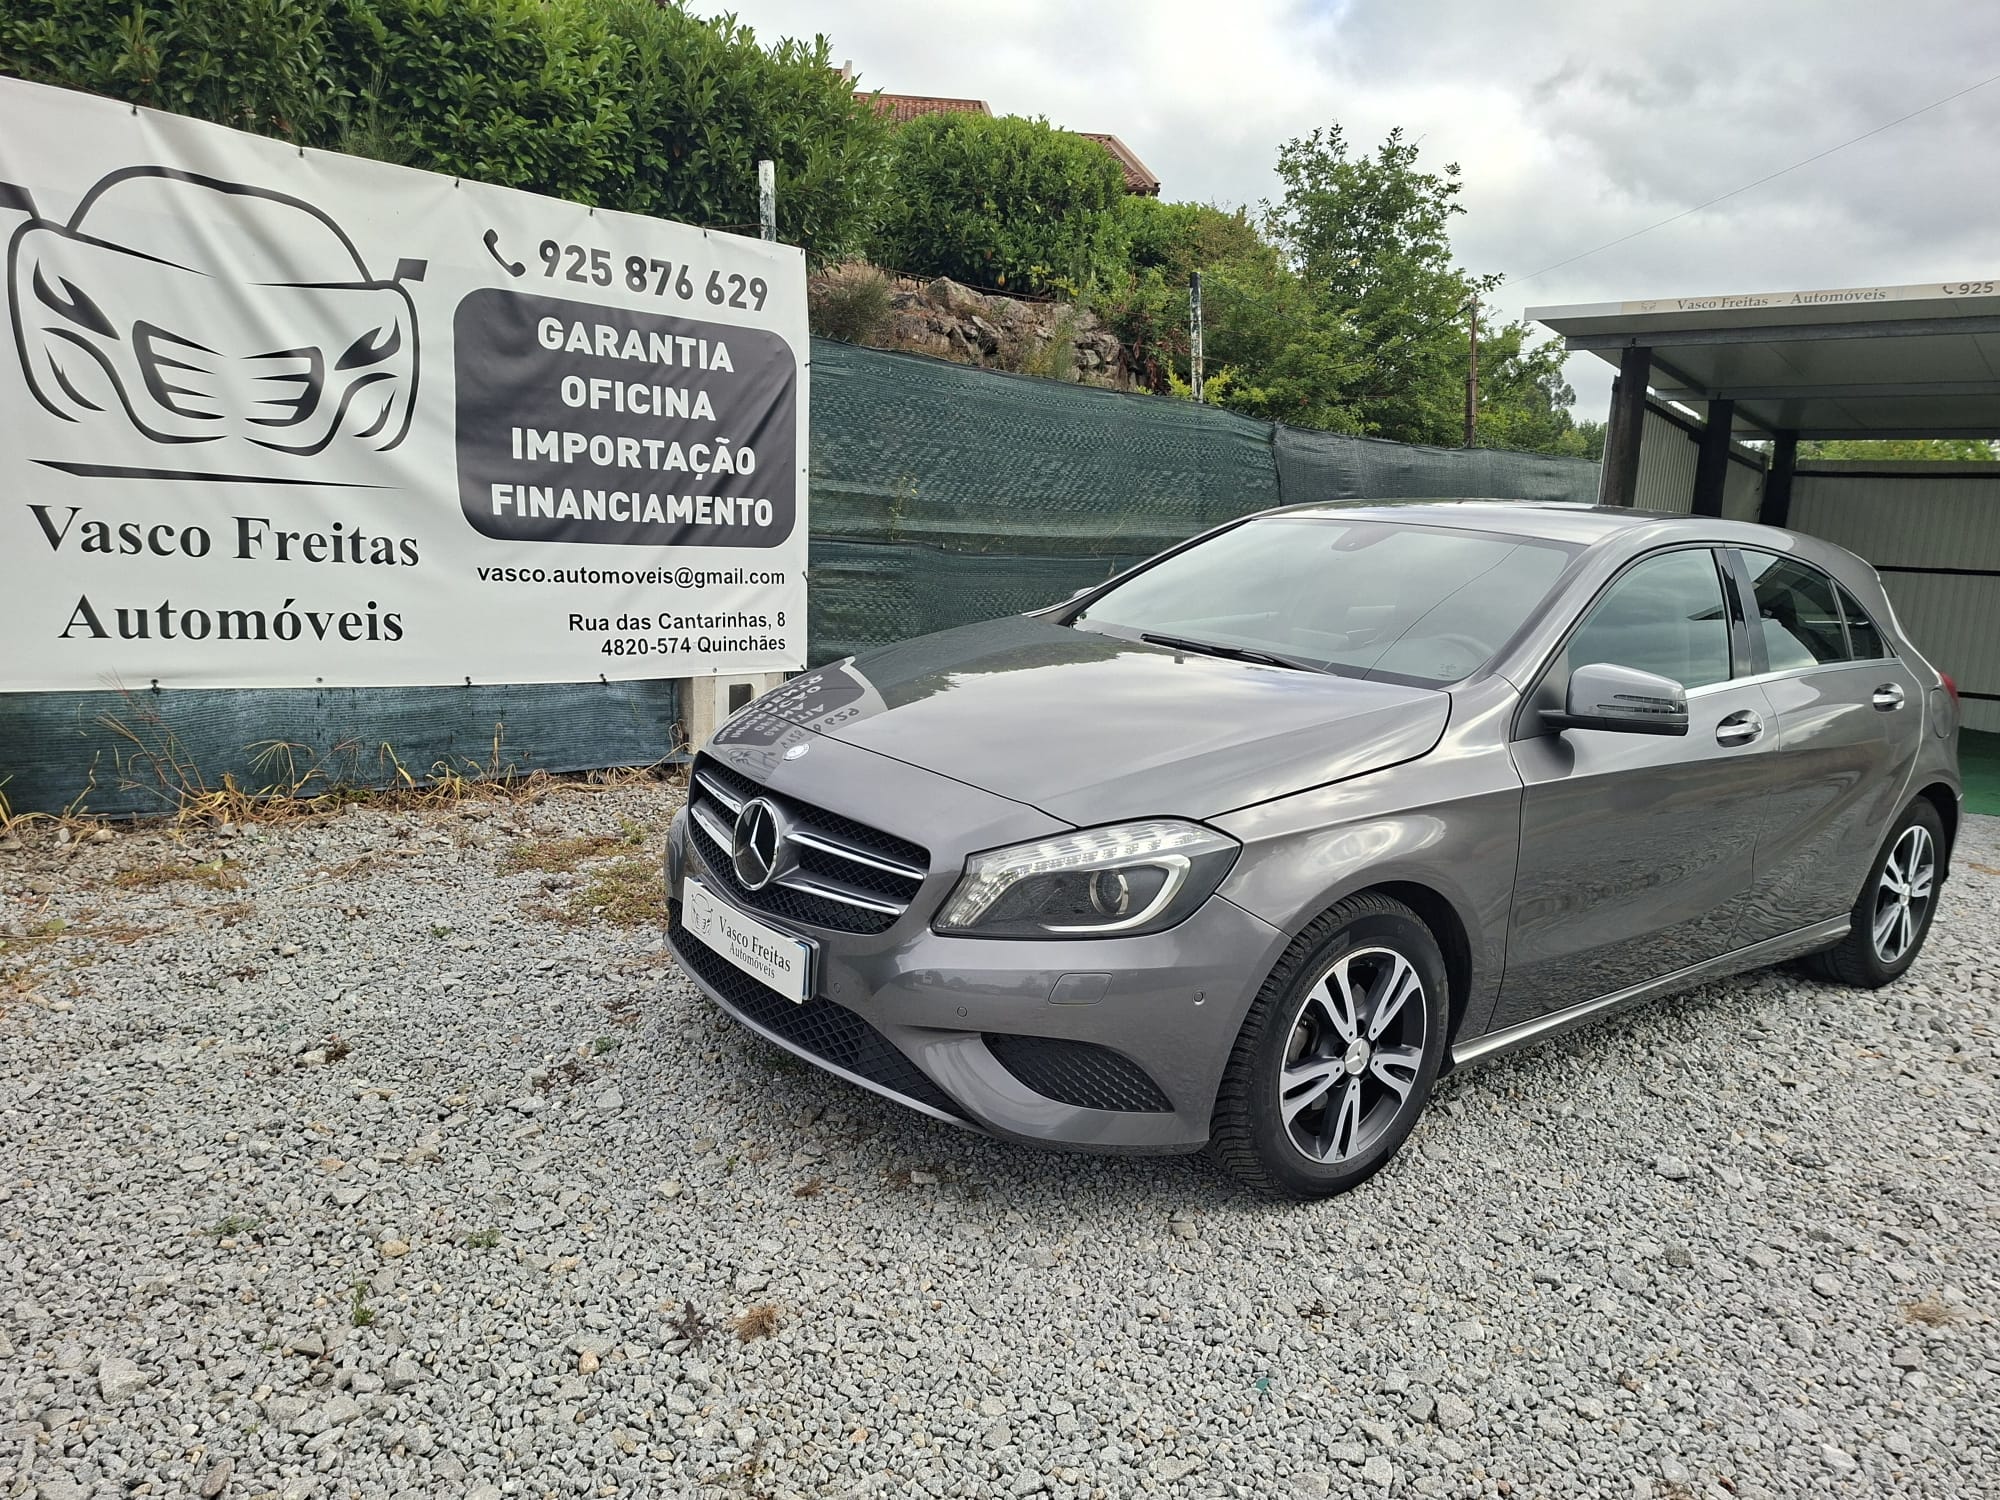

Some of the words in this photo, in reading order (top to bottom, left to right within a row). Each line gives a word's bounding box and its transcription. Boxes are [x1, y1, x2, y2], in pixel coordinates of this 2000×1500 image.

[538, 239, 613, 287] 925
[624, 255, 694, 301] 876
[705, 270, 768, 312] 629
[1959, 281, 1994, 294] 925
[1678, 299, 1716, 310] Vasco
[1721, 296, 1768, 308] Freitas
[1790, 288, 1886, 304] Automóveis
[537, 316, 735, 373] GARANTIA
[561, 375, 717, 422] OFICINA
[511, 427, 756, 481] IMPORTAÇÃO
[491, 483, 773, 527] FINANCIAMENTO
[26, 503, 211, 558] Vasco
[231, 516, 420, 567] Freitas
[476, 566, 785, 589] vasco.automoveis@gmail.com
[57, 594, 404, 642] Automóveis
[568, 613, 609, 632] Rua
[616, 613, 651, 631] das
[658, 611, 772, 631] Cantarinhas,
[777, 611, 786, 628] 8
[601, 637, 692, 656] 4820-574
[697, 635, 786, 654] Quinchães
[719, 915, 749, 948] Vasco
[751, 935, 791, 972] Freitas
[729, 942, 775, 979] Automóveis
